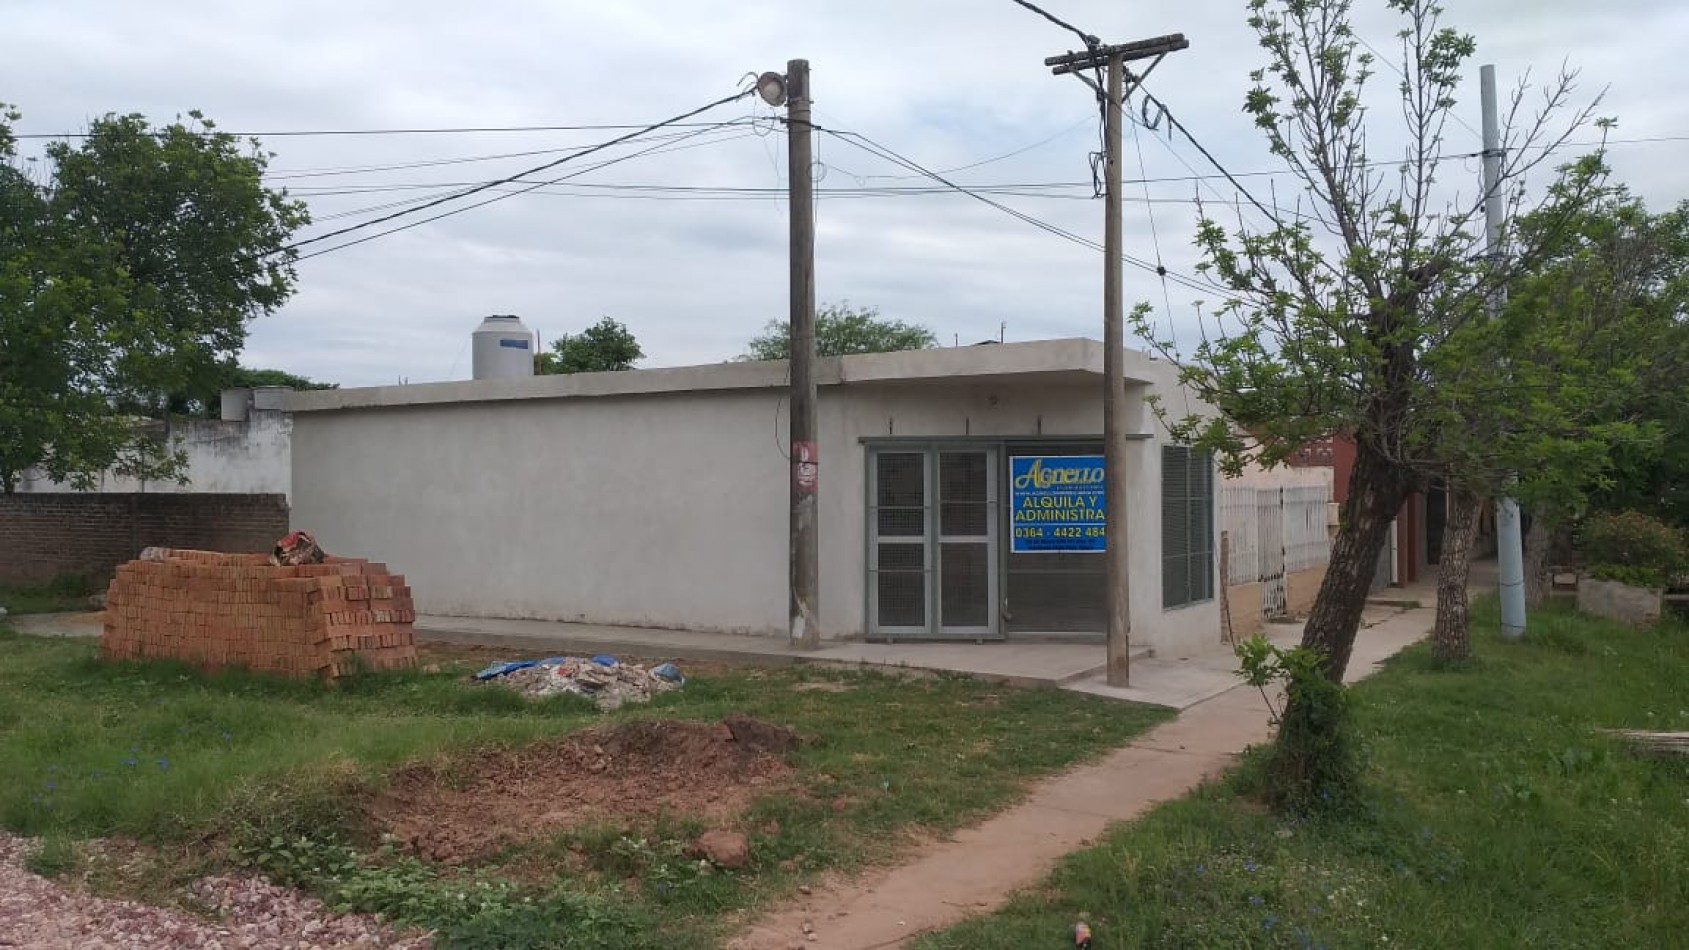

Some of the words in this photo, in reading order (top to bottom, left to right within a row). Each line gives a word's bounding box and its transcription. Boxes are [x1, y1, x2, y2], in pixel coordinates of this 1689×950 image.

[1023, 496, 1085, 508] ALQUILA
[1089, 496, 1097, 507] Y
[1015, 509, 1105, 521] ADMINISTRA
[1015, 527, 1043, 538] 0364
[1053, 527, 1082, 538] 4422
